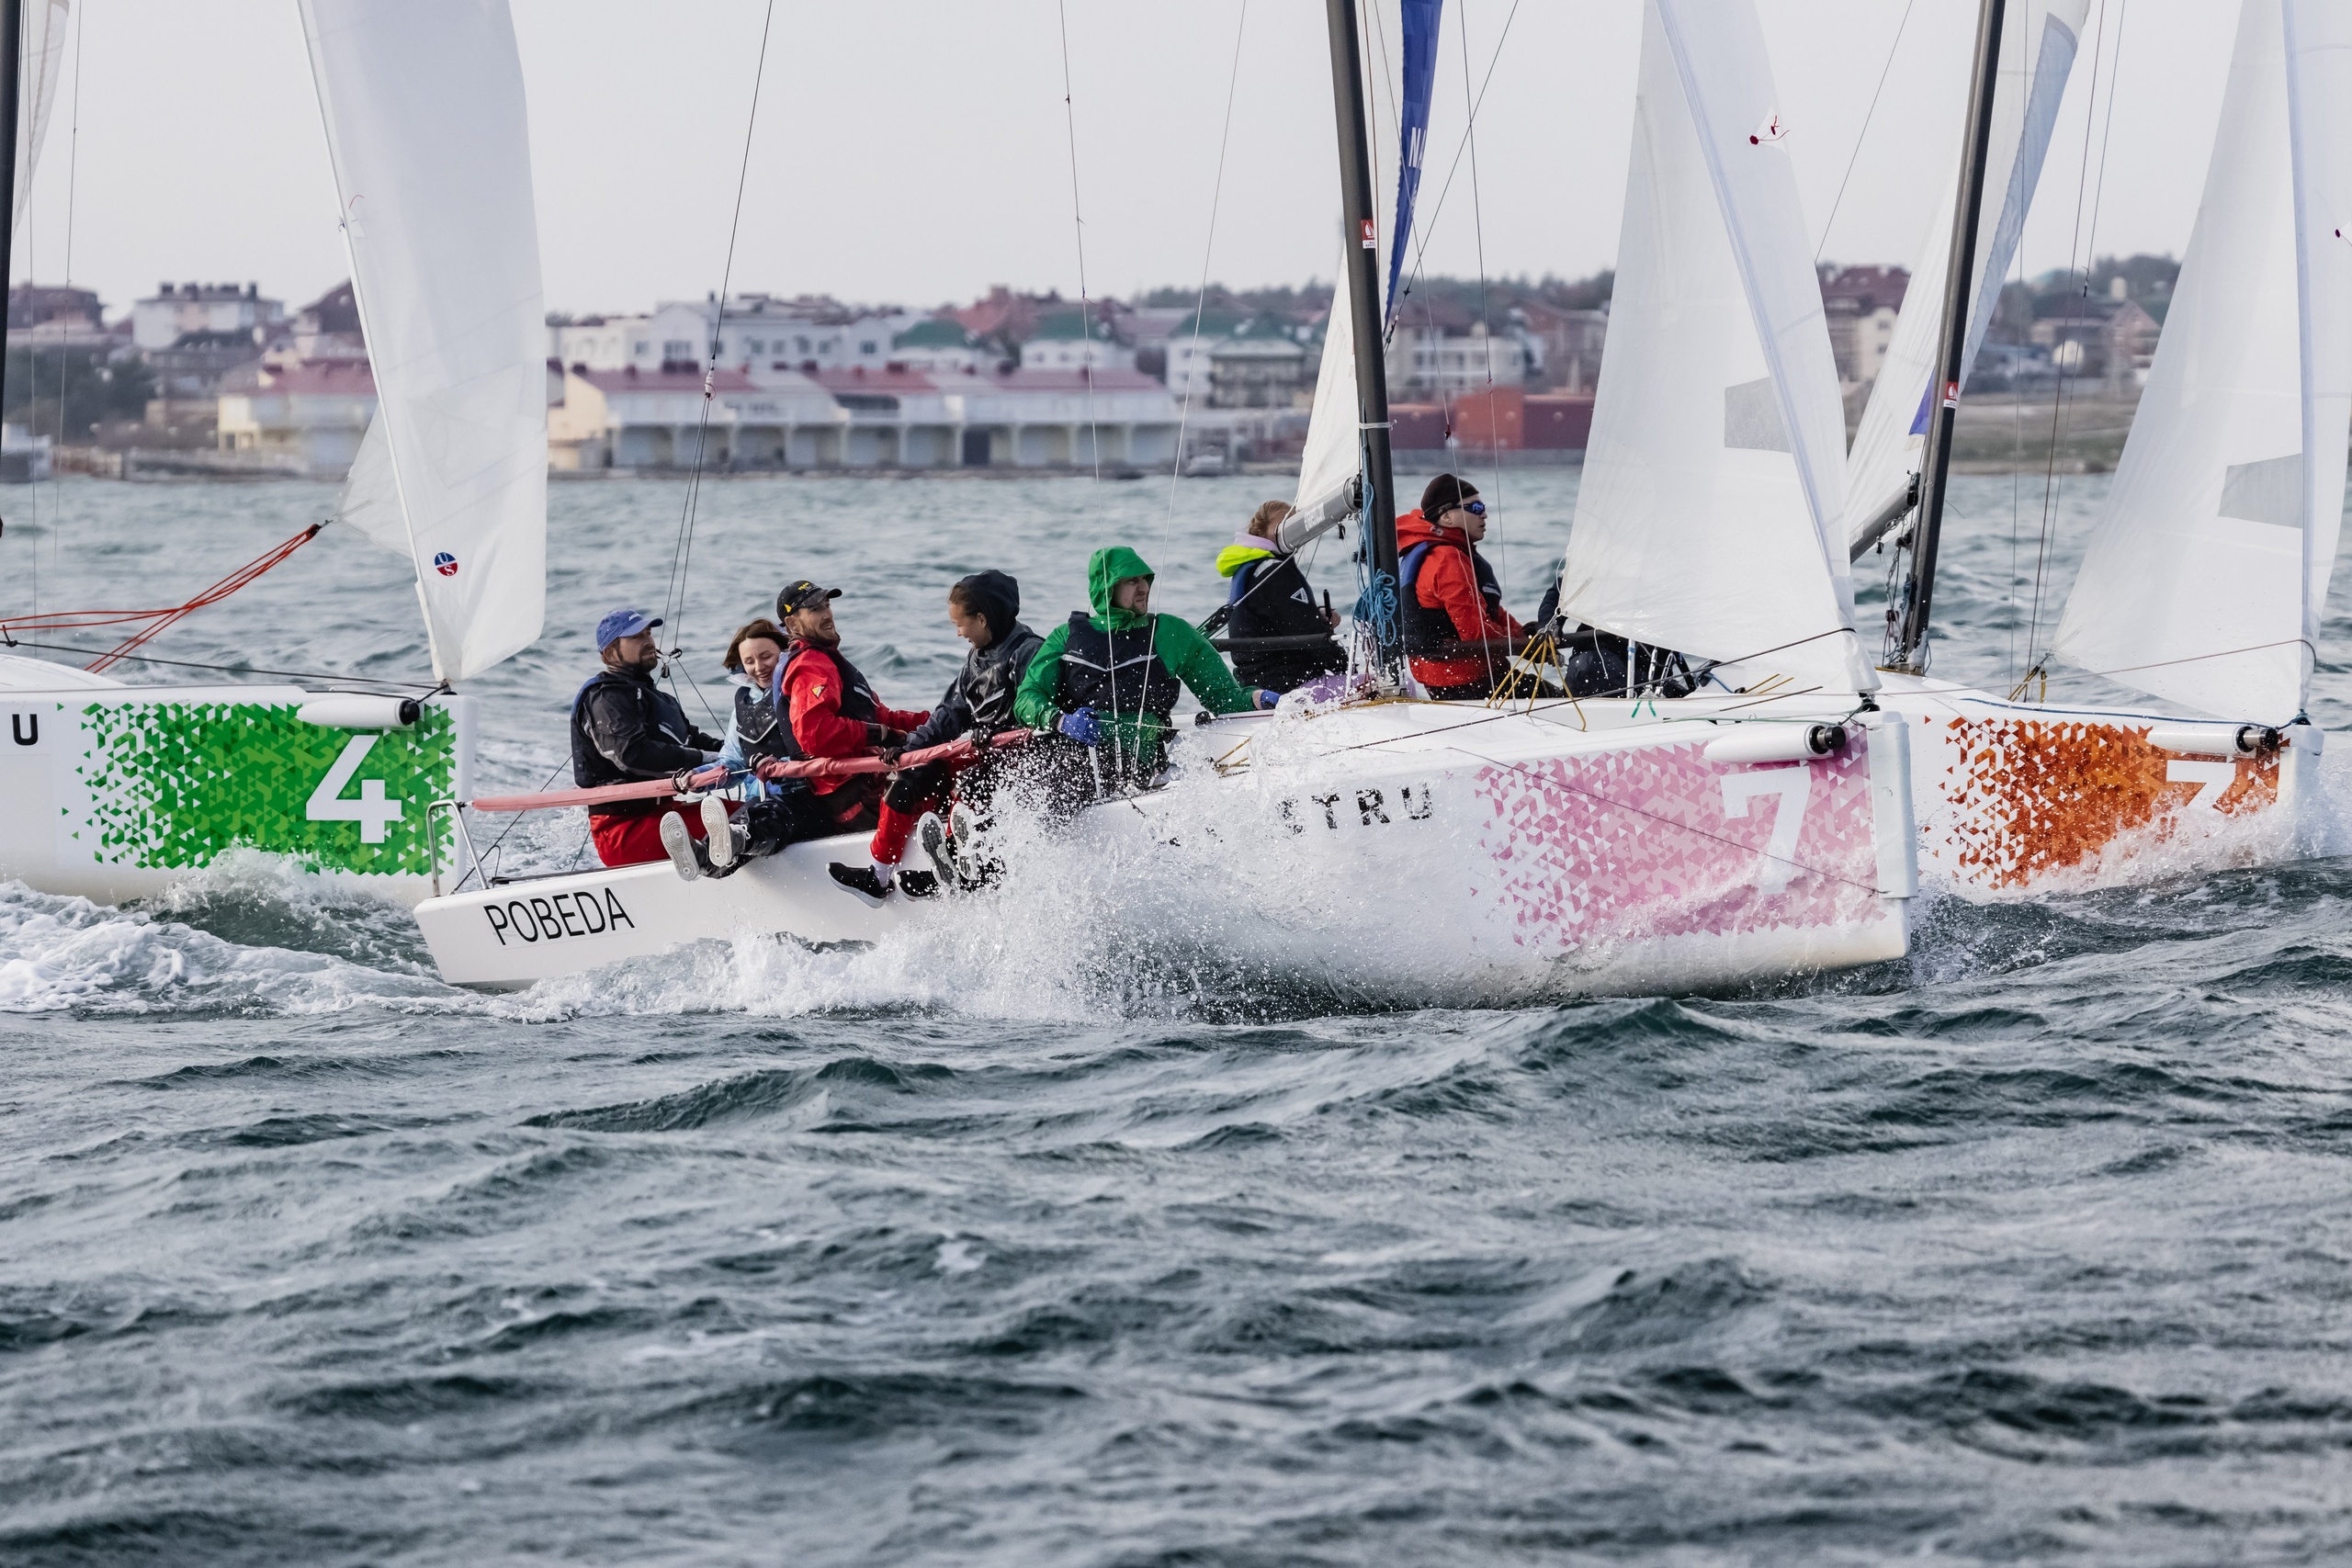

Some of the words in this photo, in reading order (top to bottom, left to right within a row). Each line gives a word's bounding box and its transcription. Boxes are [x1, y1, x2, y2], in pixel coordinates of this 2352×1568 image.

[12, 713, 39, 746] U
[305, 734, 402, 844] 4
[1719, 765, 1813, 896] 7
[482, 886, 636, 946] POBEDA
